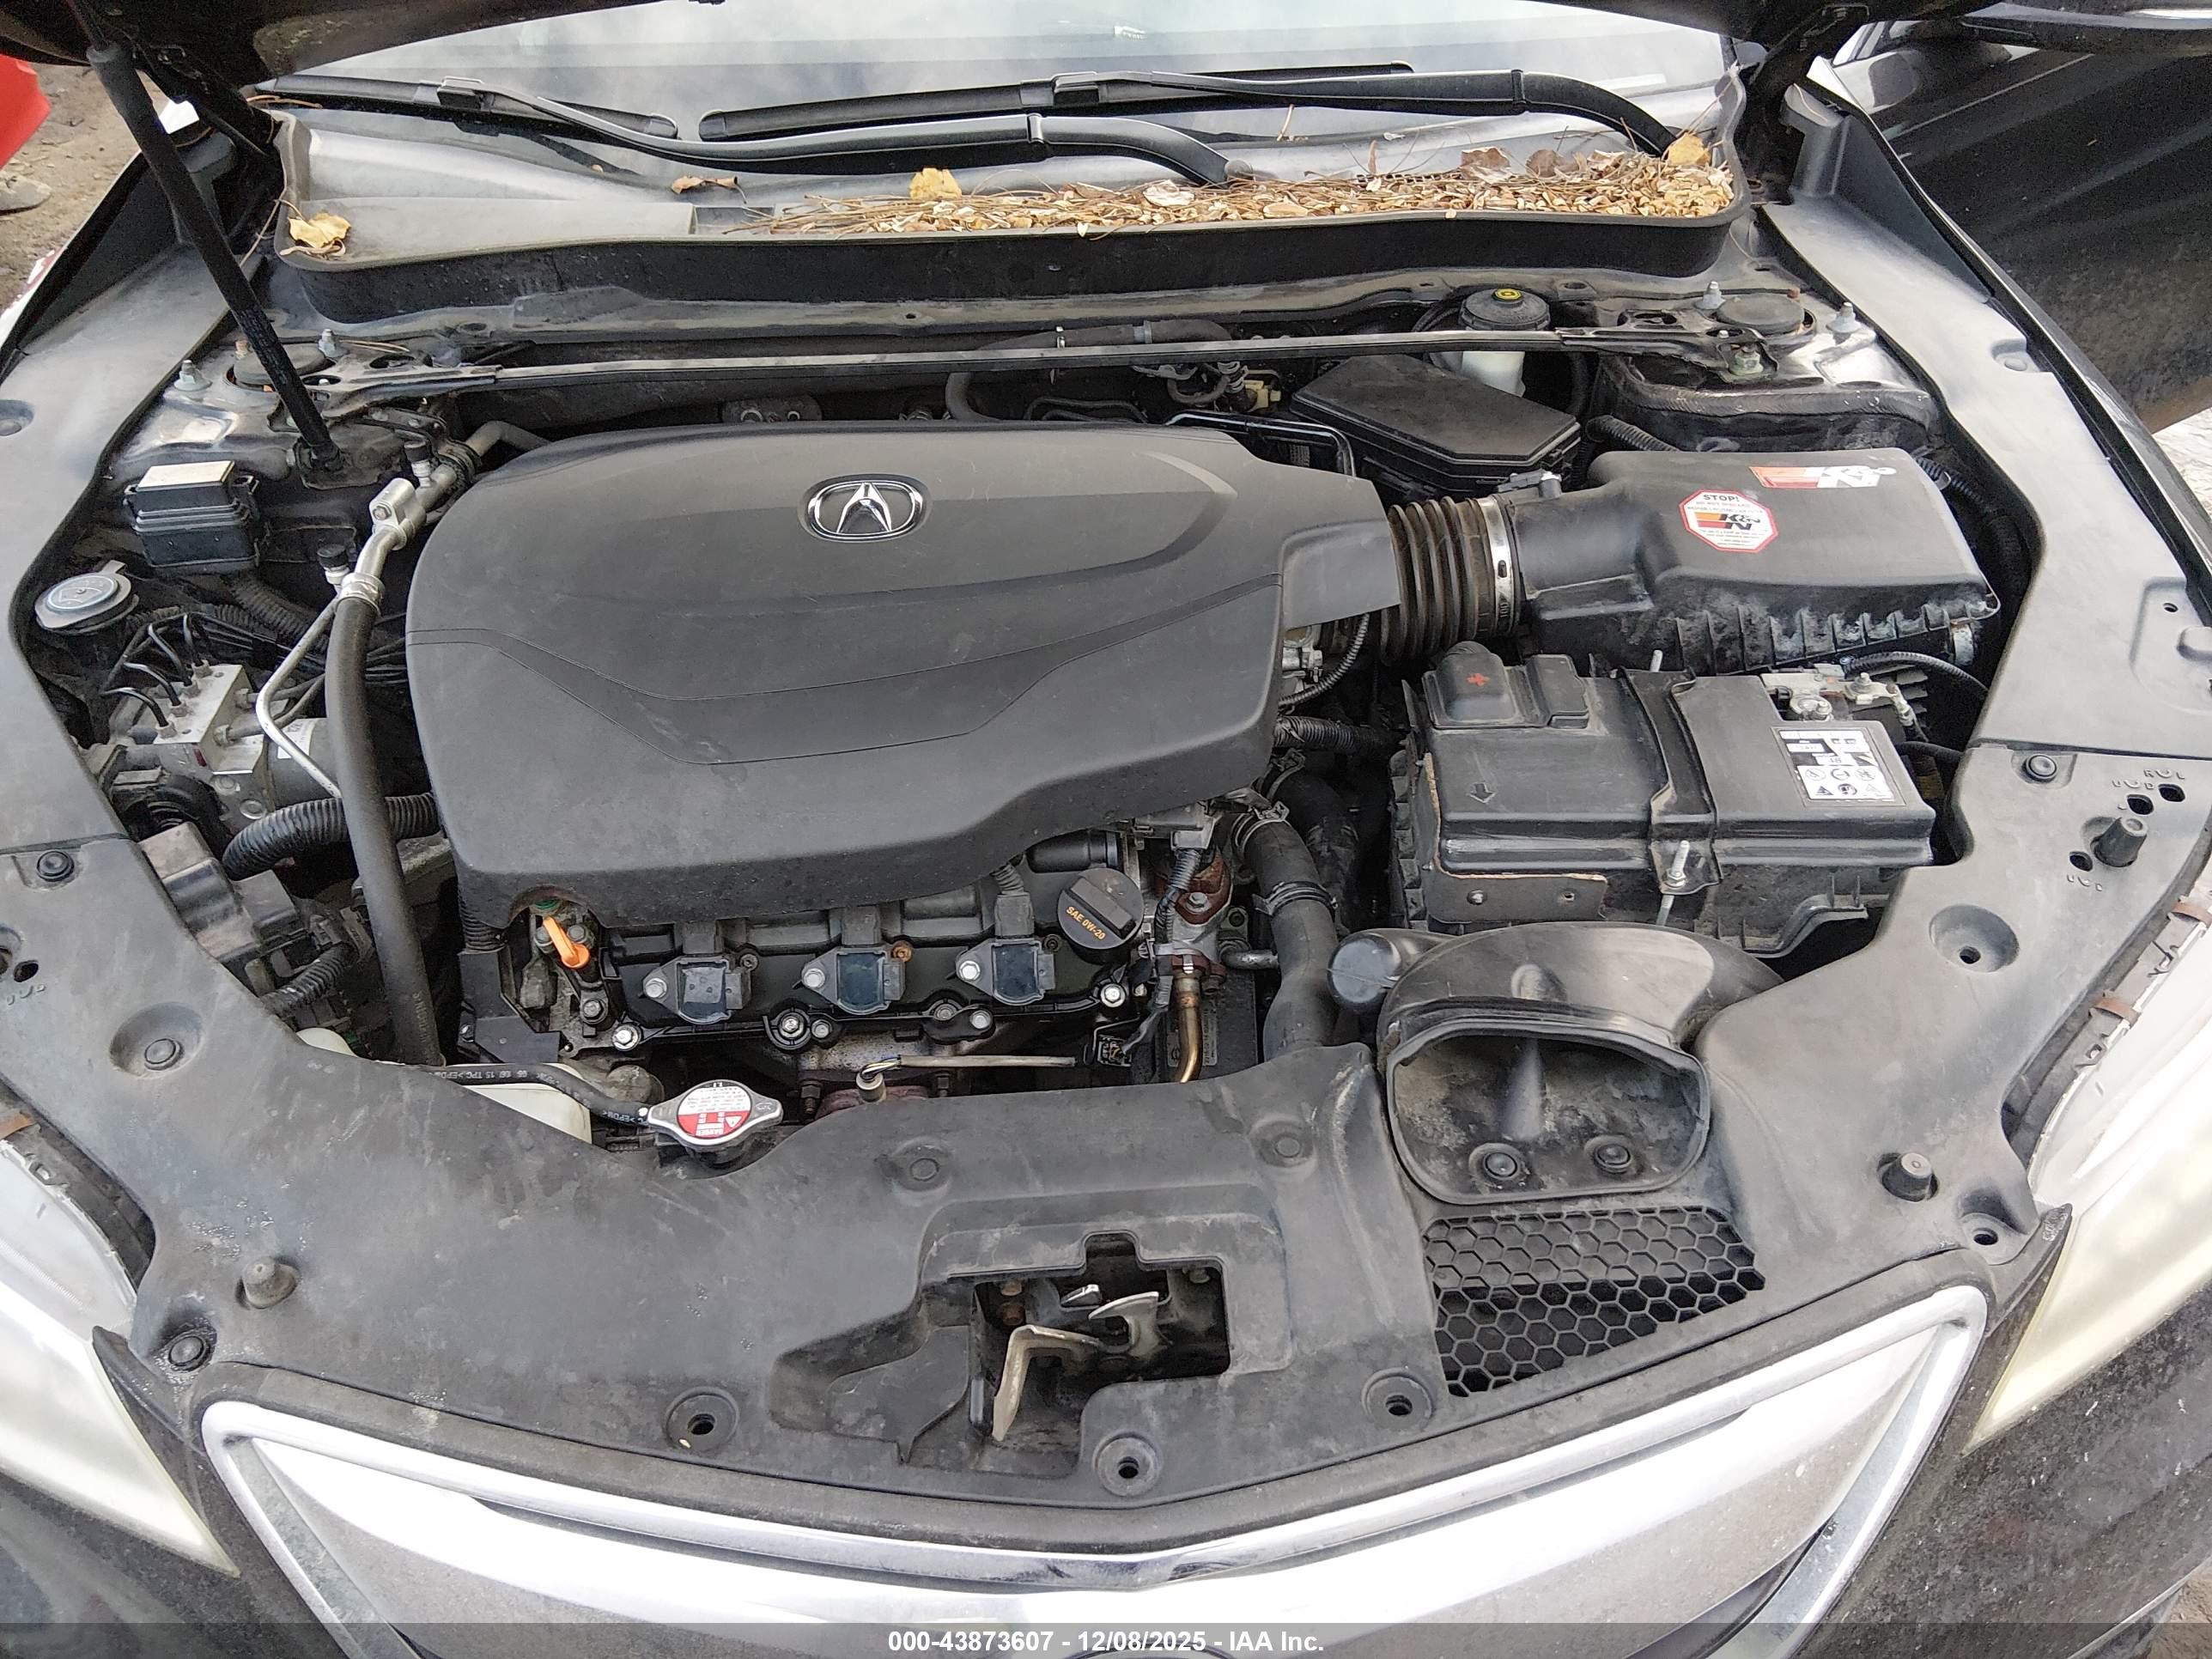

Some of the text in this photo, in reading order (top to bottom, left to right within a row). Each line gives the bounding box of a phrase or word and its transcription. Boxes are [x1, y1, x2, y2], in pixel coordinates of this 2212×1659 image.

[1718, 514, 1761, 531] K&N
[1066, 906, 1106, 940] SAE 0W-20
[465, 1070, 483, 1079] TPC
